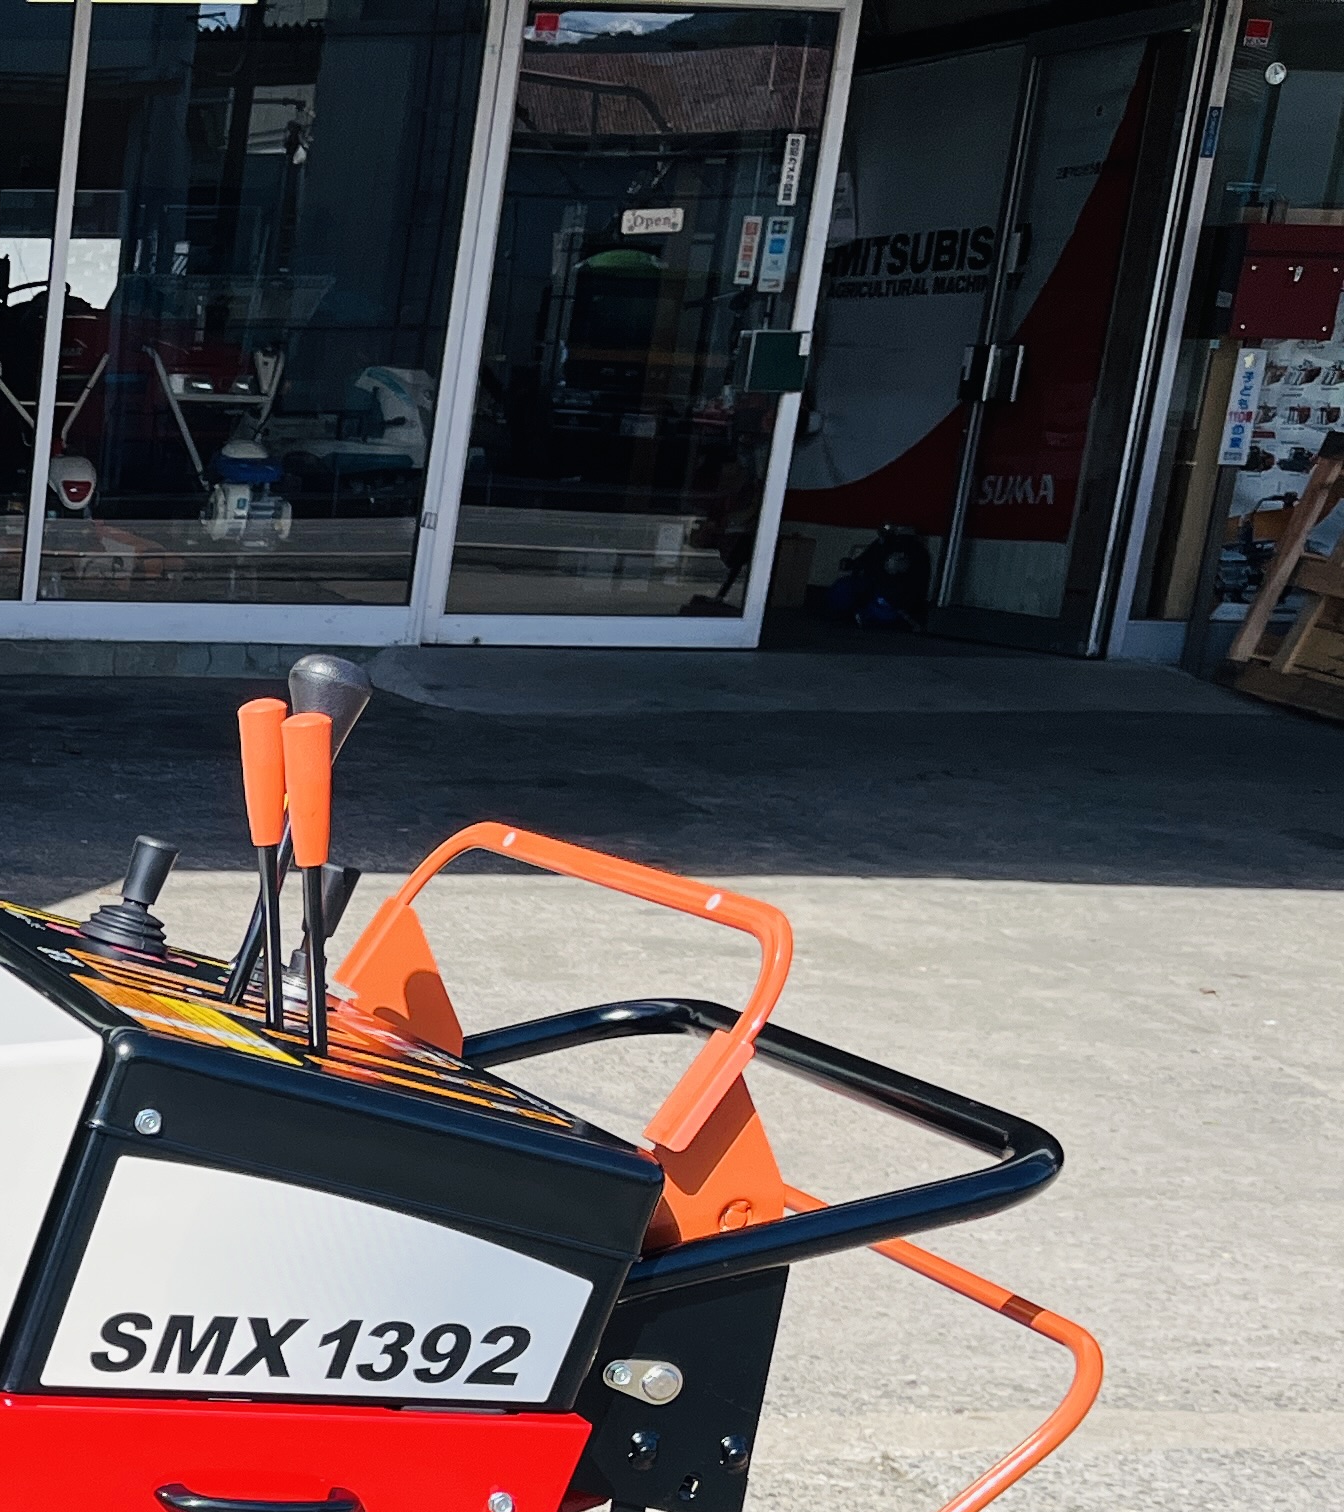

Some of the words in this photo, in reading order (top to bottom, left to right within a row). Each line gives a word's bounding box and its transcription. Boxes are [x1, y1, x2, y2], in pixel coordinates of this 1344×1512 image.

[632, 214, 672, 230] Open
[832, 223, 1032, 277] MITSUBISI
[89, 1312, 310, 1378] SMX
[316, 1318, 532, 1386] 1392
